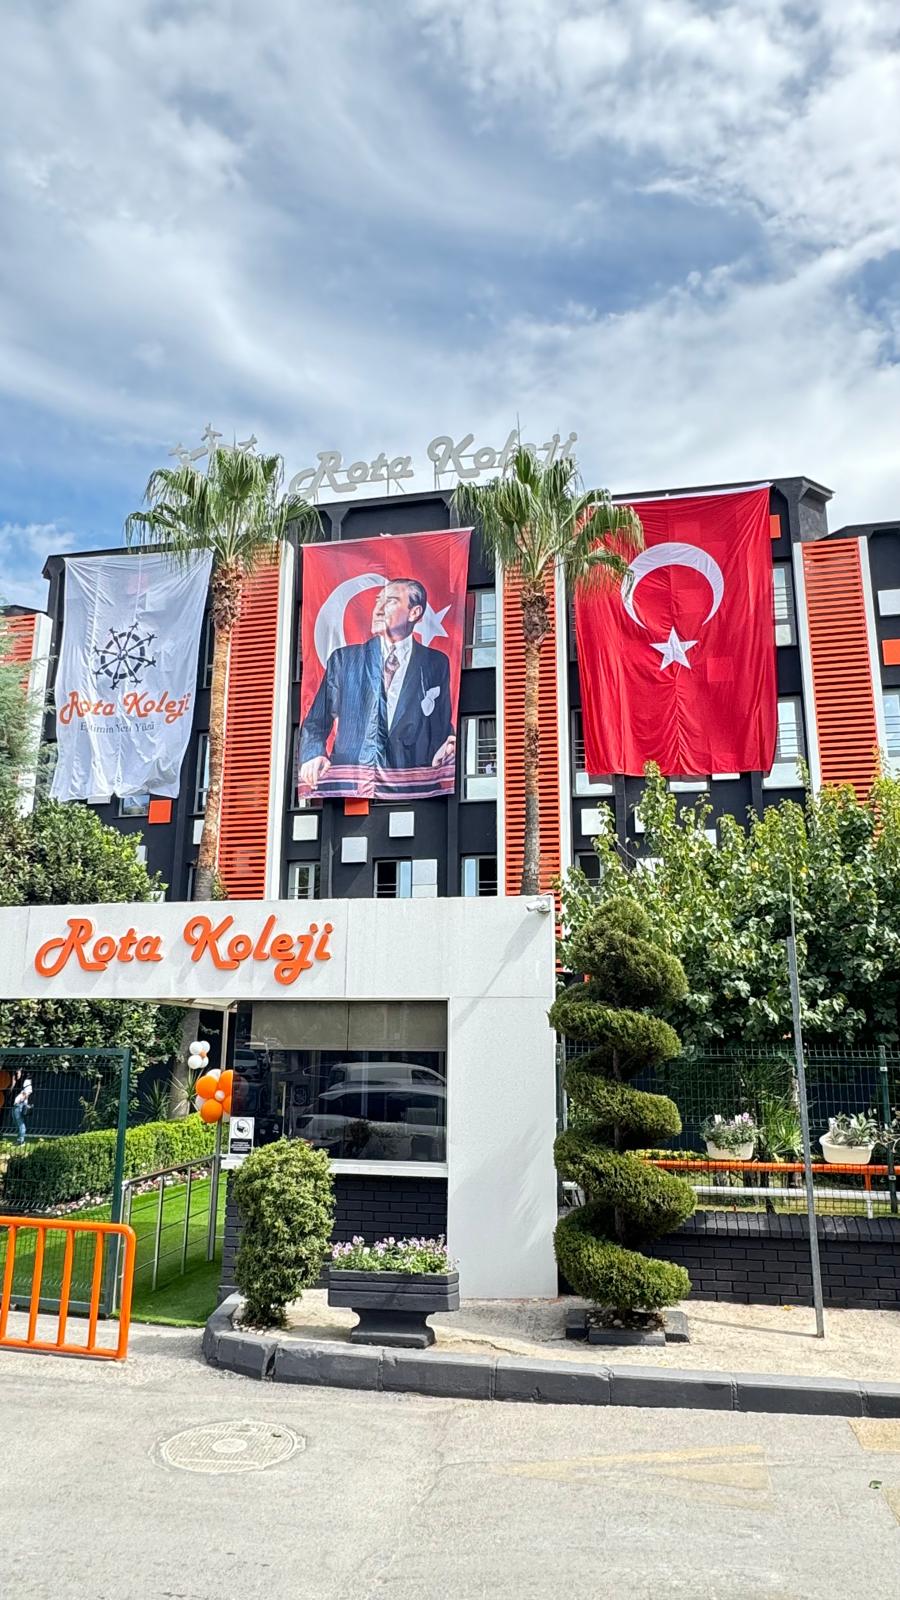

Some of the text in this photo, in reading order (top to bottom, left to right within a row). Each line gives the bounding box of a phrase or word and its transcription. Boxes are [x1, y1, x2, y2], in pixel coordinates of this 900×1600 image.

[289, 451, 414, 499] Rota
[59, 691, 191, 725] Rota Koleji
[34, 914, 332, 985] Rota Koleji
